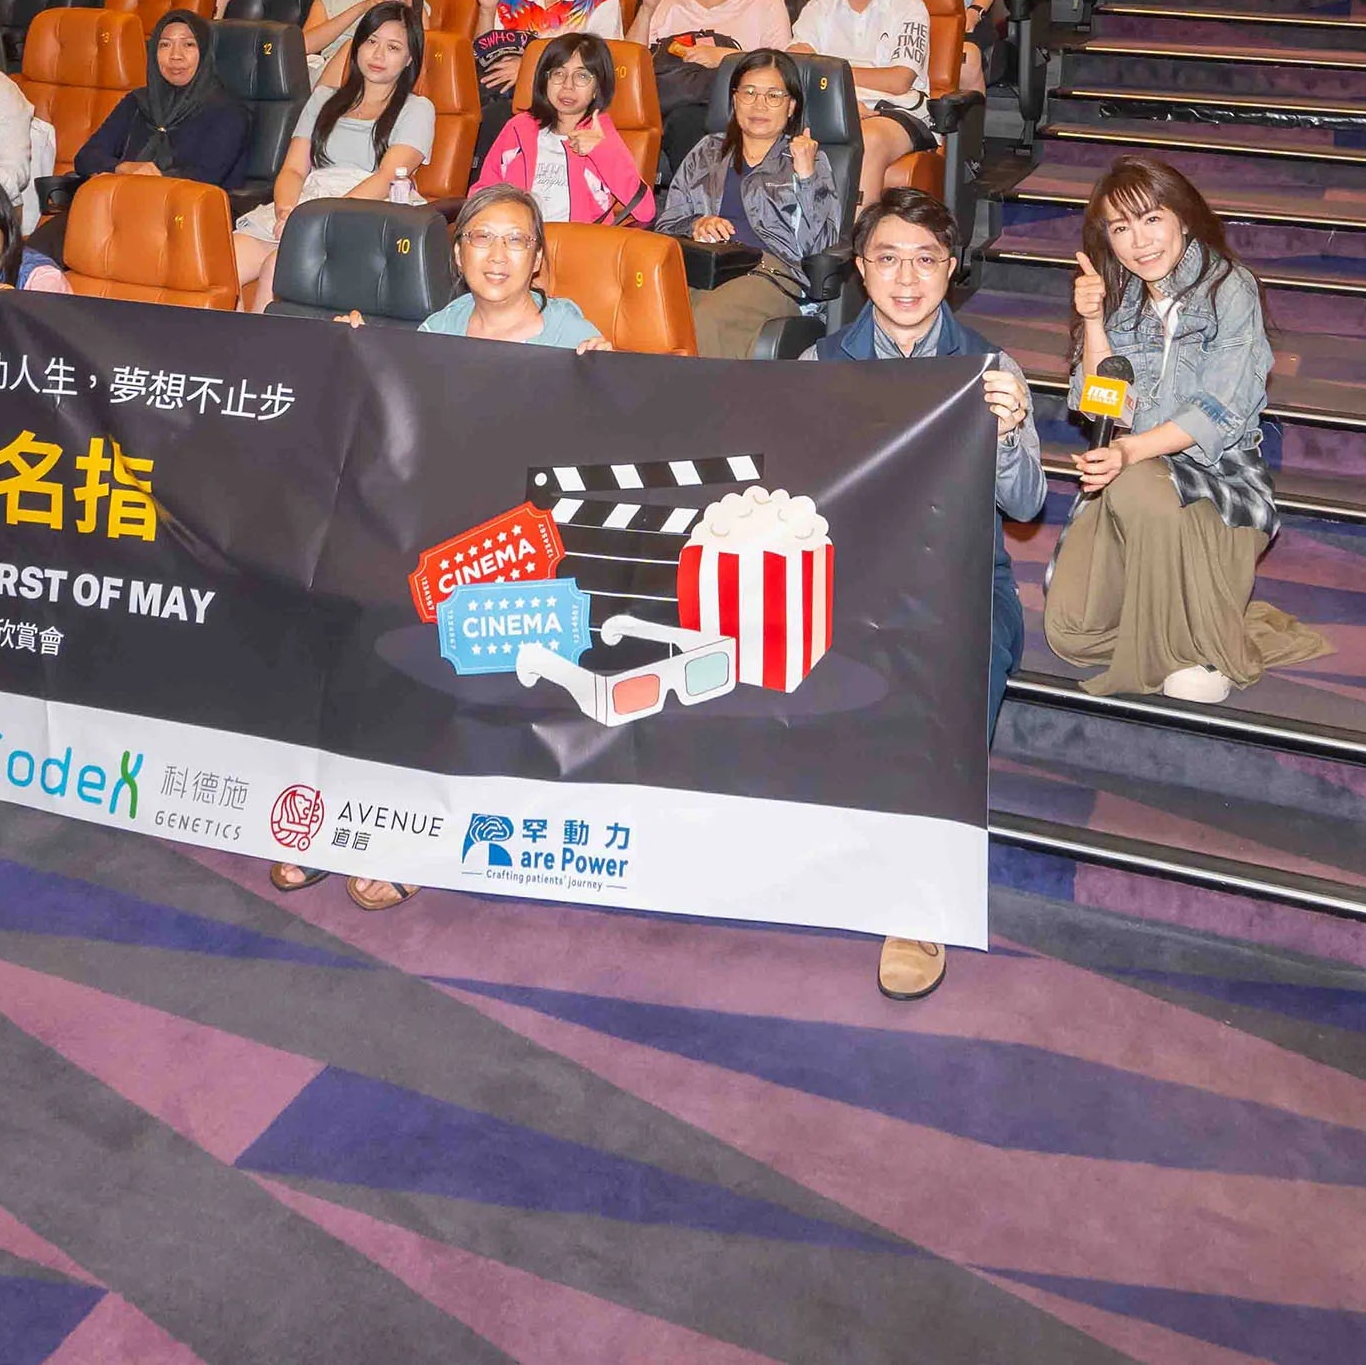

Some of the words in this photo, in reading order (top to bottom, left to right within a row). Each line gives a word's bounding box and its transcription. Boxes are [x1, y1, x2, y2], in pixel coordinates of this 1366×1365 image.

[903, 21, 928, 38] THE
[263, 43, 273, 55] 12
[615, 66, 627, 79] 10
[820, 77, 828, 90] 9
[396, 238, 410, 255] 10
[635, 271, 644, 288] 9
[438, 538, 537, 595] CINEMA
[72, 573, 124, 611] OF
[128, 580, 216, 624] MAY
[462, 612, 563, 639] CINEMA
[160, 764, 251, 811] 科德施
[155, 810, 243, 841] GENETICS
[337, 800, 444, 838] AVENUE
[331, 826, 371, 852] 道信
[522, 818, 631, 851] 罕動力
[561, 847, 629, 878] Power
[486, 869, 524, 884] Crafting
